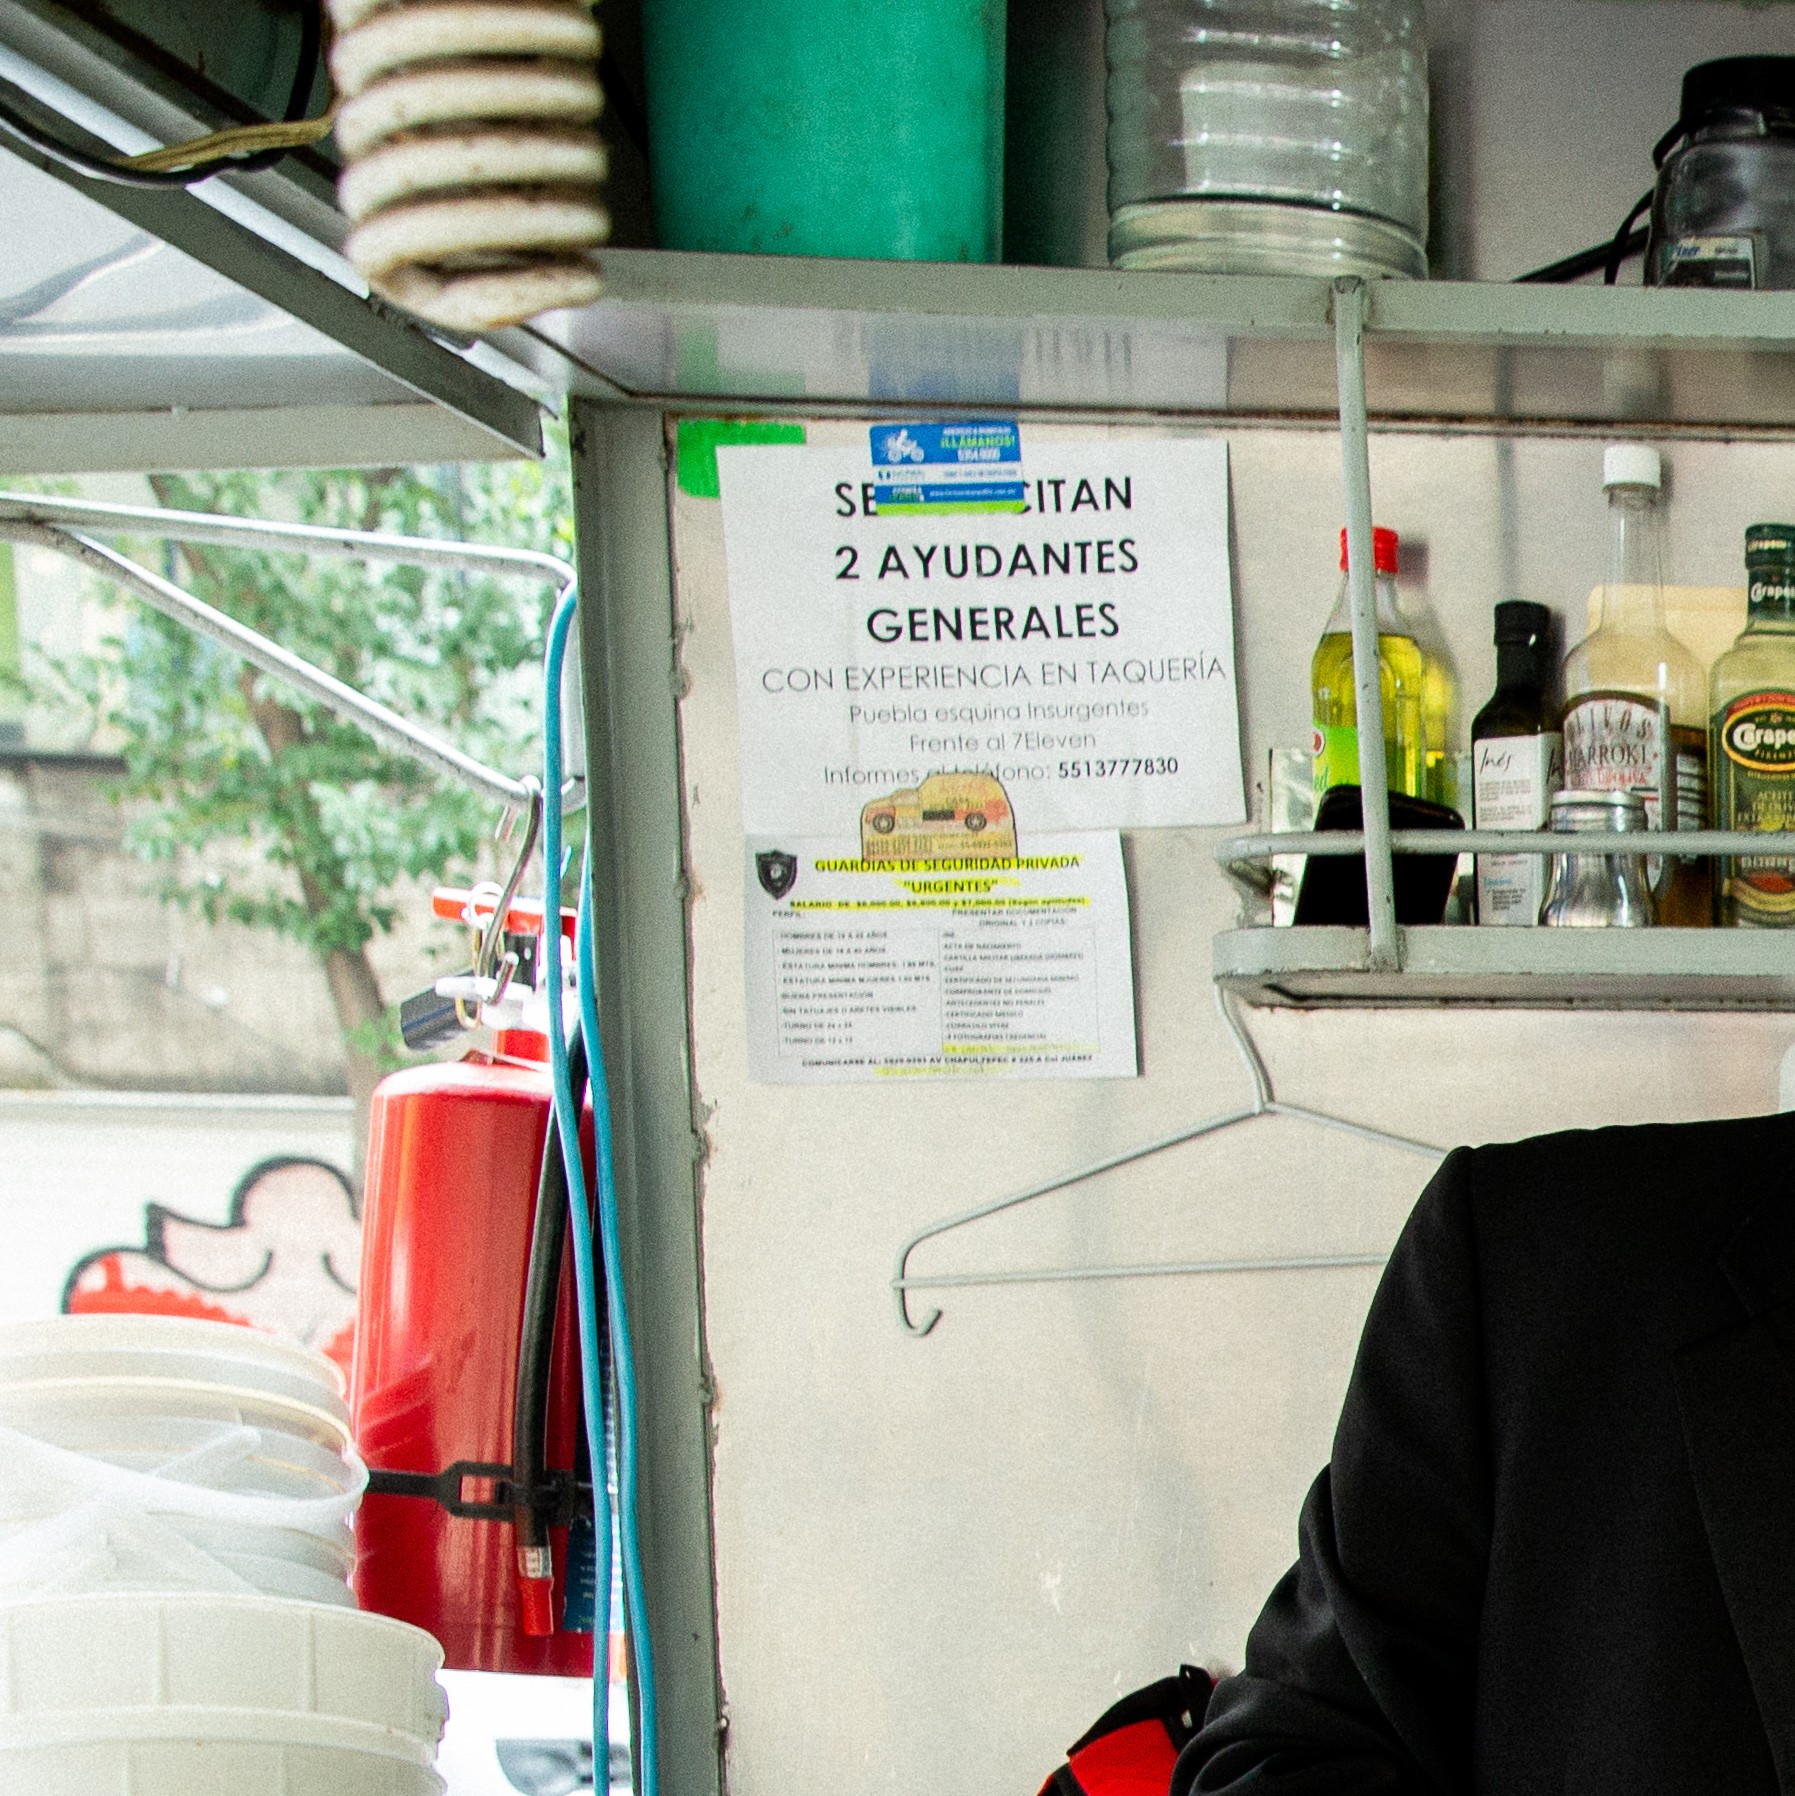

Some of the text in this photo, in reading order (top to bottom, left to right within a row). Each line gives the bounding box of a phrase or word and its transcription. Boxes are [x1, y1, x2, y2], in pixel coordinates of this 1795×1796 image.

[834, 482, 876, 517] SE
[834, 538, 1139, 580] 2 AYUDANTES
[866, 602, 1120, 643] GENERALES
[762, 651, 1227, 694] CON EXPERIENCIA EN TAQUERÍA
[849, 698, 1150, 728] Puebla esquina Insurgentes
[909, 730, 1097, 753] Frente al 7Eleven
[824, 764, 920, 786] Informes
[1058, 756, 1179, 780] 5513777830
[815, 859, 895, 873] GUARDIAS
[1016, 855, 1080, 870] PRIVADA
